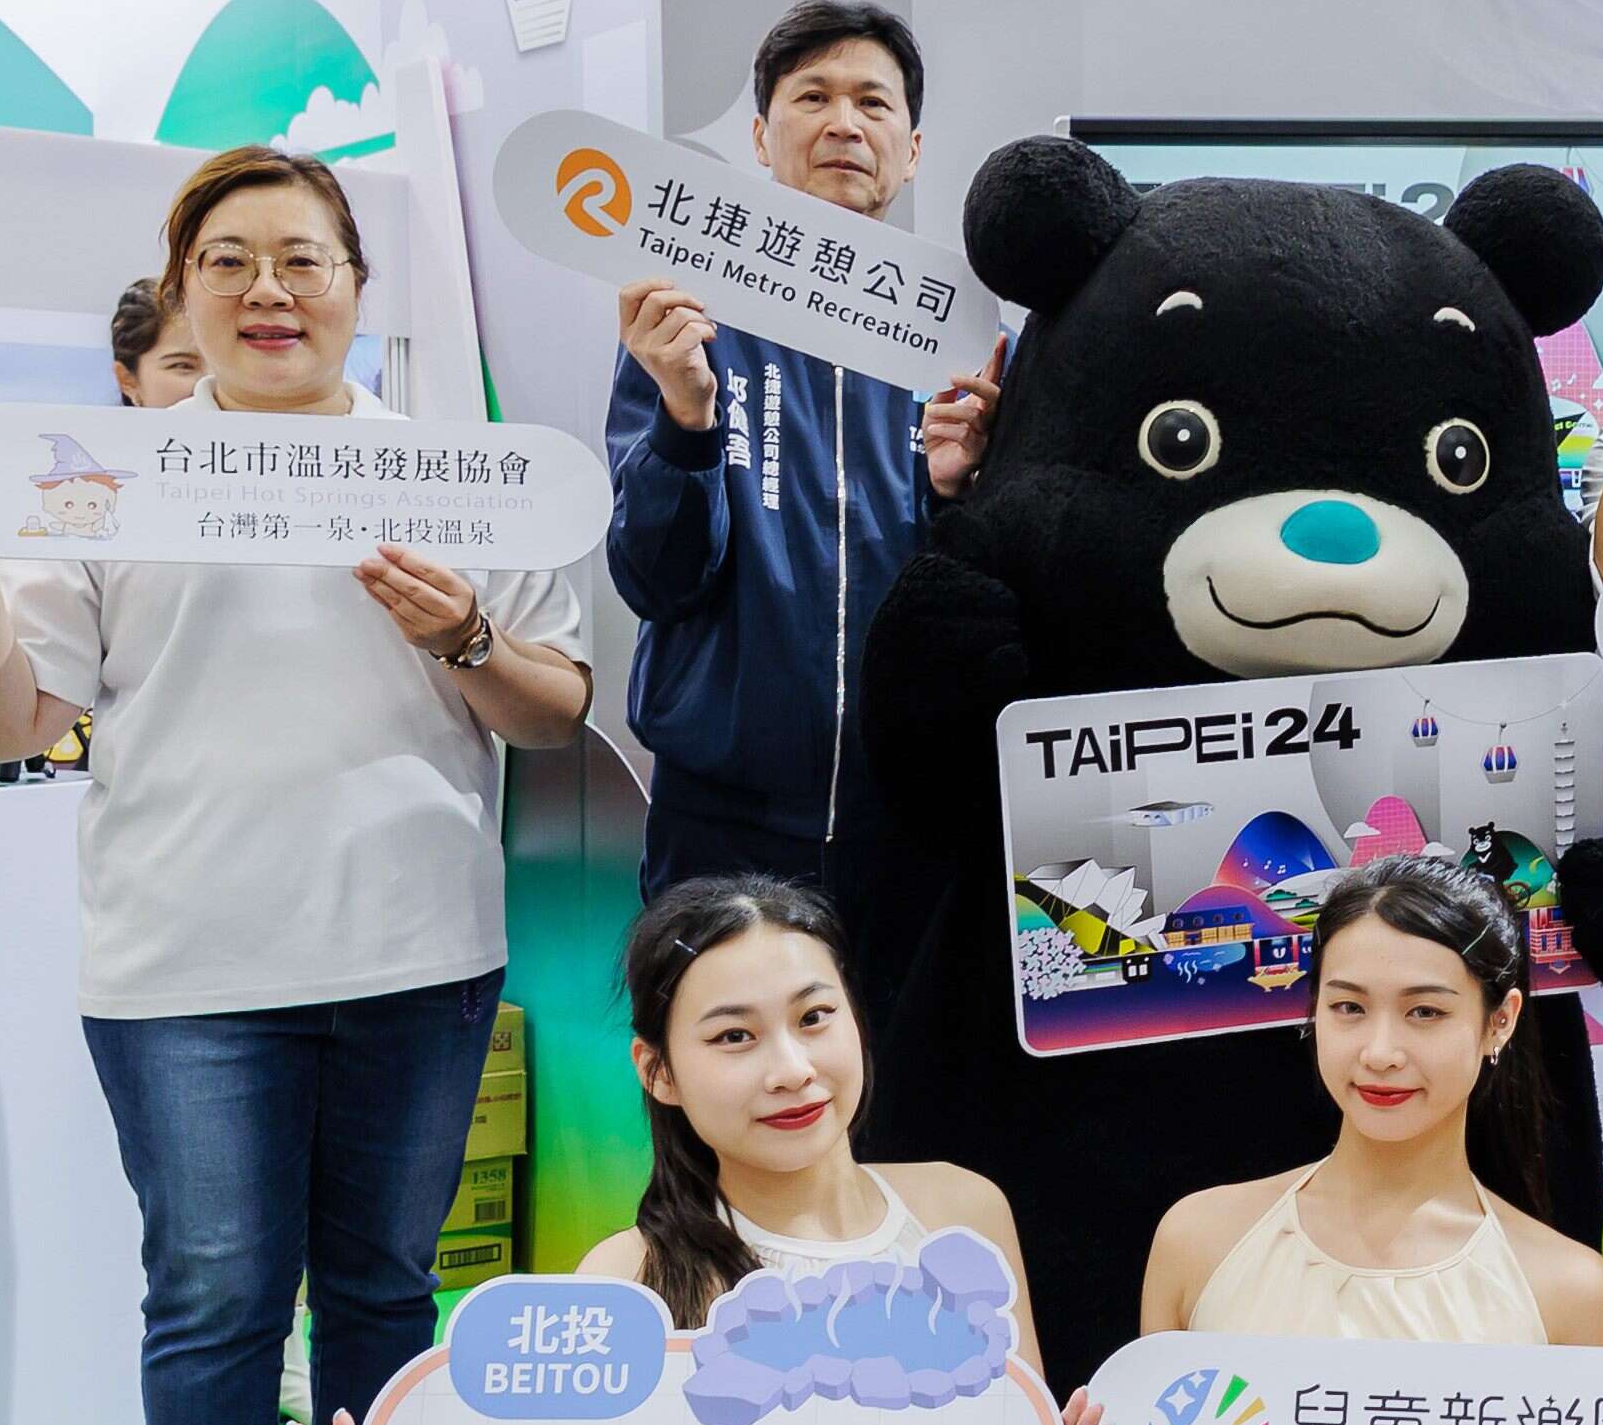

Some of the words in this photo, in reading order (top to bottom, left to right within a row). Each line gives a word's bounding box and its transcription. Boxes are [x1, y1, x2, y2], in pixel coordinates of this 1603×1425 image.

[646, 178, 958, 324] 北捷遊憩公司
[638, 227, 714, 273] Taipei
[722, 258, 797, 302] Metro
[806, 289, 940, 355] Recreation
[155, 437, 532, 486] 台北市溫泉發展協會
[157, 481, 232, 505] Taipei
[241, 484, 287, 505] Hot
[295, 485, 387, 510] Springs
[396, 488, 535, 512] Association
[507, 1303, 614, 1357] 北投
[482, 1360, 631, 1398] BEITOU
